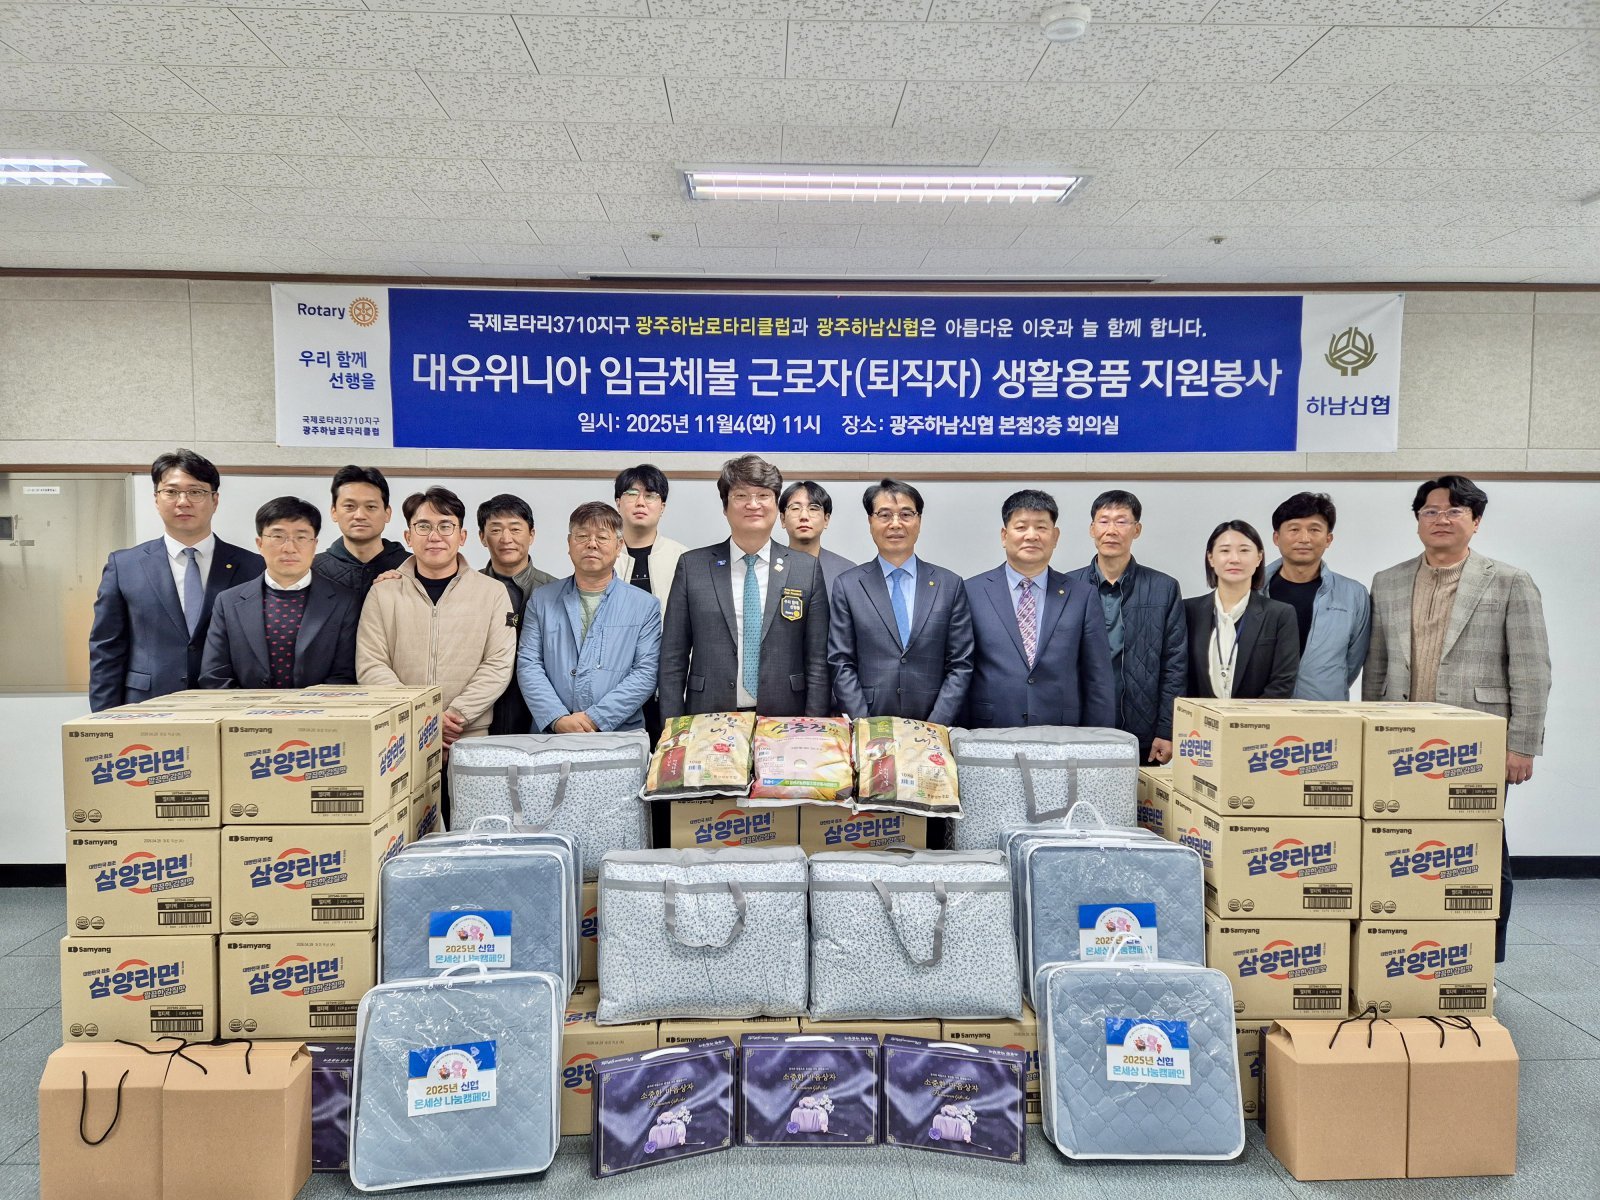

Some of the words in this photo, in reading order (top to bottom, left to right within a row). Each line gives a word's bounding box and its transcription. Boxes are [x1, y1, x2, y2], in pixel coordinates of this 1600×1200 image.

[297, 302, 346, 320] Rotary
[468, 313, 631, 334] 국제로타리3710지구
[636, 315, 808, 336] 광주하남로타리클럽과
[817, 317, 936, 338] 광주하남신협은
[945, 318, 1013, 338] 아름다운
[1022, 318, 1074, 338] 이웃과
[1081, 318, 1099, 338] 늘
[1107, 318, 1142, 338] 함께
[1150, 318, 1207, 338] 합니다.
[299, 351, 331, 369] 우리
[335, 350, 368, 369] 함께
[329, 372, 376, 390] 선행을
[412, 353, 591, 395] 대유위니아
[599, 355, 738, 397] 임금체불
[748, 357, 982, 398] 근로자(퇴직자)
[992, 357, 1131, 398] 생활용품
[1140, 358, 1283, 398] 지원봉사
[1306, 394, 1391, 416] 하남신협
[302, 415, 380, 426] 국제로타리3710지구
[302, 425, 380, 437] 광주하남로타리클럽
[578, 411, 621, 433] 일시:
[626, 413, 689, 434] 2025년
[694, 414, 777, 435] 11월4(화)
[782, 415, 821, 435] 11시
[842, 415, 885, 435] 장소:
[889, 415, 994, 436] 광주하남신협
[998, 416, 1063, 436] 본점3층
[1066, 416, 1120, 436] 회의실
[1179, 739, 1211, 758] 삼양라면
[1247, 739, 1333, 773] 삼양라면
[1393, 743, 1477, 776] 삼양라면
[91, 747, 184, 784] 삼양라면
[250, 743, 340, 779] 삼양라면
[695, 812, 771, 844] 삼양라면
[824, 816, 901, 845] 삼양라면
[250, 851, 341, 888] 삼양라면
[1248, 842, 1332, 876] 삼양라면
[1390, 844, 1474, 878] 삼양라면
[95, 854, 187, 892] 삼양라면
[435, 954, 461, 964] 온세상
[463, 954, 505, 964] 나눔캠페인
[445, 944, 476, 953] 2025년
[478, 944, 495, 953] 신협
[1238, 943, 1321, 977] 삼양라면
[1386, 944, 1467, 978] 삼양라면
[89, 962, 179, 999] 삼양라면
[248, 958, 339, 995] 삼양라면
[1113, 1065, 1139, 1076] 온세상
[1141, 1066, 1185, 1079] 나눔캠페인
[1123, 1056, 1154, 1065] 2025년
[1156, 1056, 1174, 1067] 신협
[426, 1083, 458, 1095] 2025년
[460, 1080, 479, 1092] 신협
[641, 1089, 662, 1100] 소중한
[666, 1082, 694, 1094] 마음상자
[414, 1097, 442, 1110] 온세상
[444, 1091, 491, 1106] 나눔캠페인
